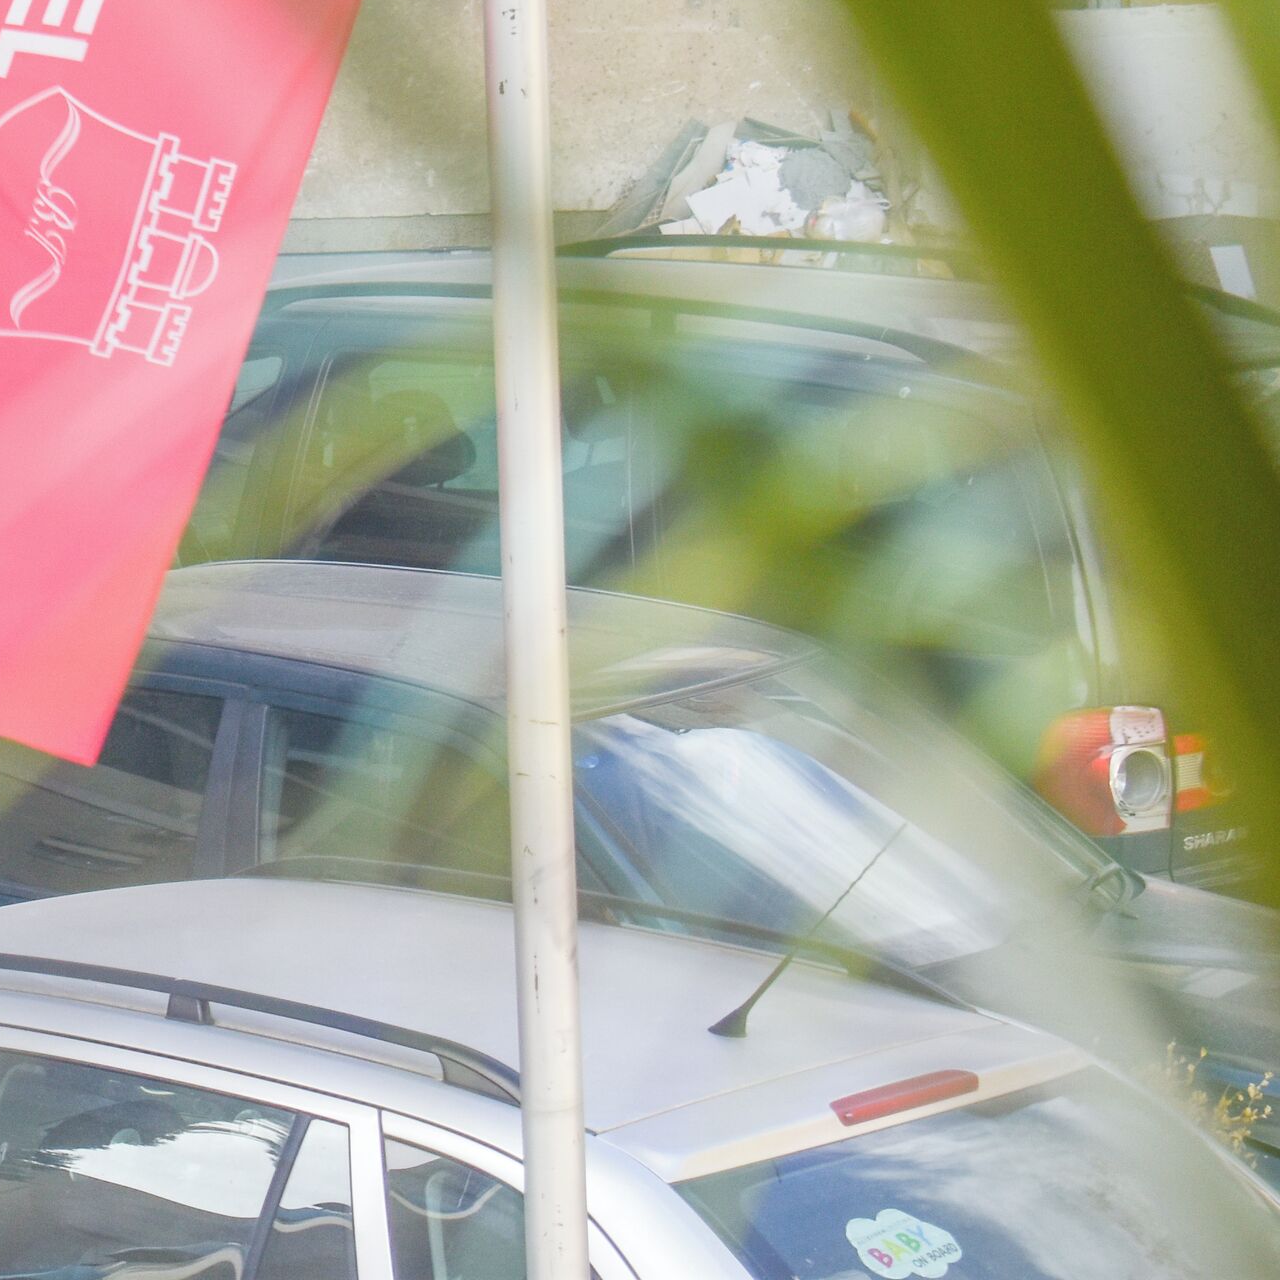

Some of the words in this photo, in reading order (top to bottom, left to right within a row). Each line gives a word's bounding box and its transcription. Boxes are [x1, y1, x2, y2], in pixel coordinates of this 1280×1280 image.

[867, 1225, 932, 1269] BABY
[911, 1256, 929, 1269] ON
[926, 1242, 959, 1262] BOARD
